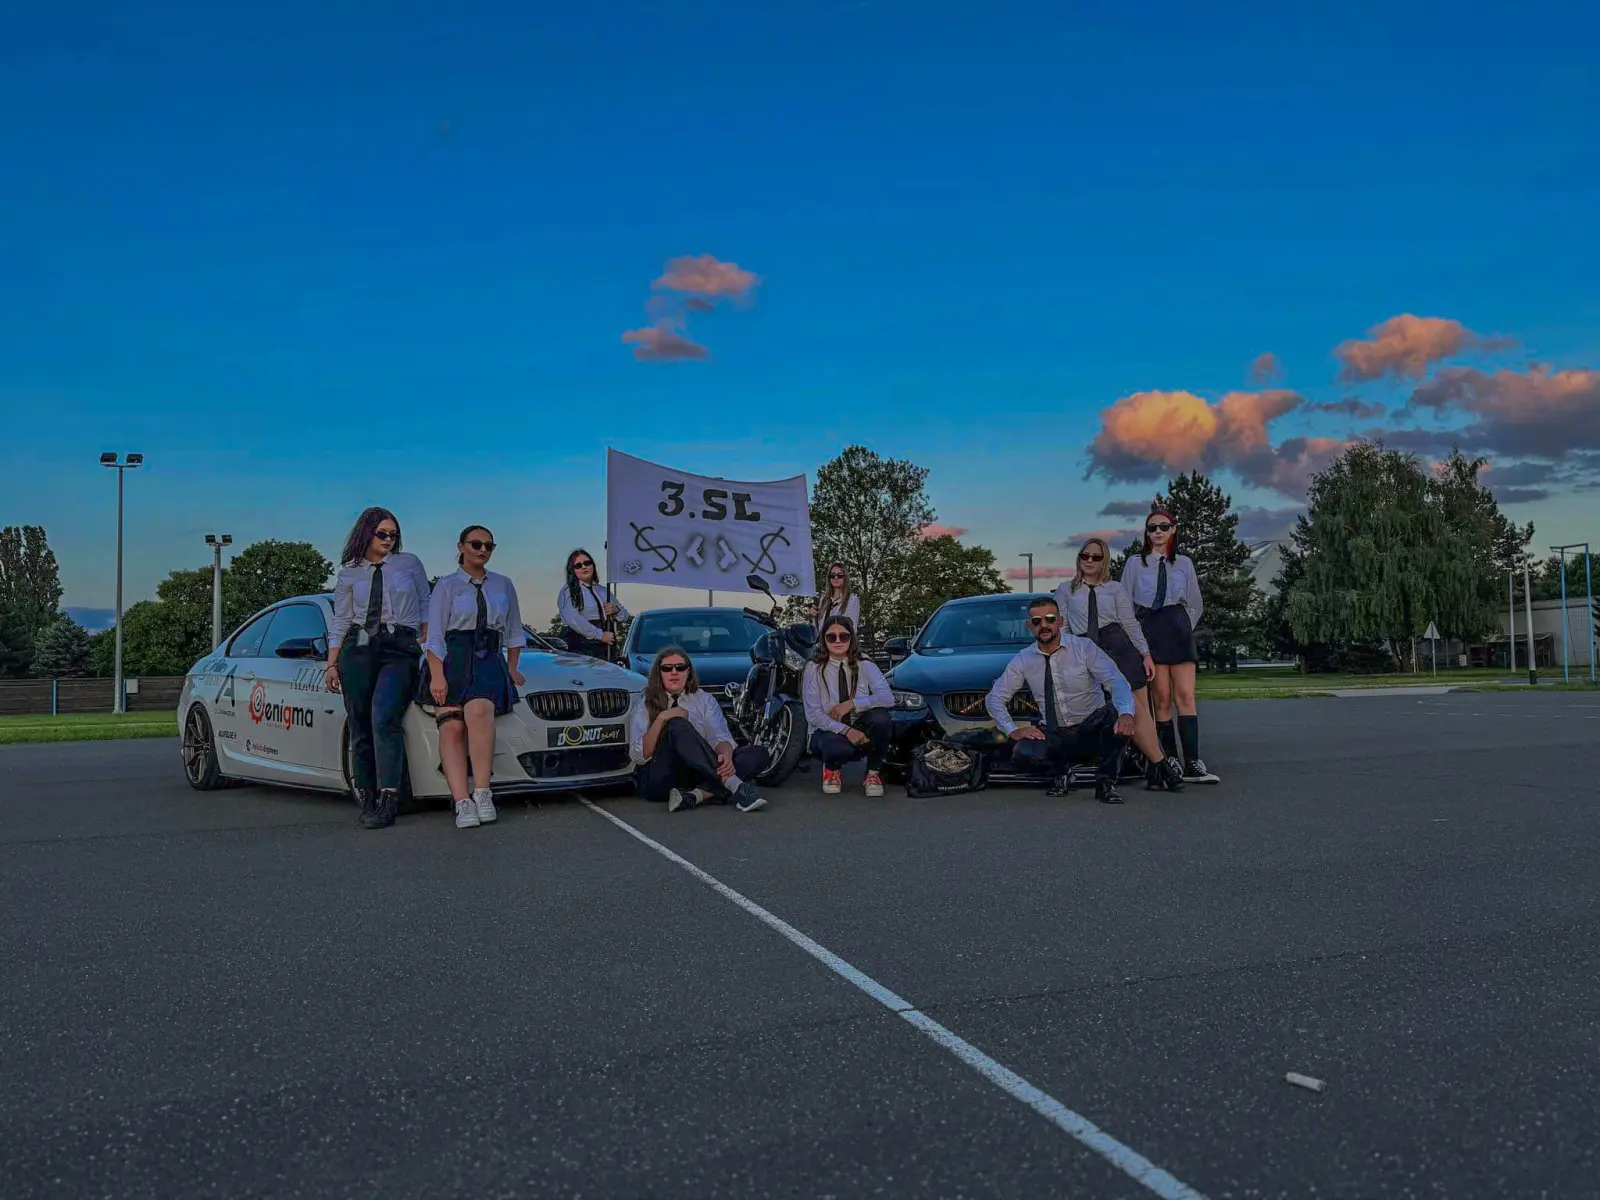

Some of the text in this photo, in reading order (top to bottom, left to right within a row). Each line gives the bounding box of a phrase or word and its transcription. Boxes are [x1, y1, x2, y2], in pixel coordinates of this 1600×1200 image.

[657, 480, 761, 522] 3.SL
[265, 698, 313, 730] enigma
[557, 725, 604, 746] DONUT
